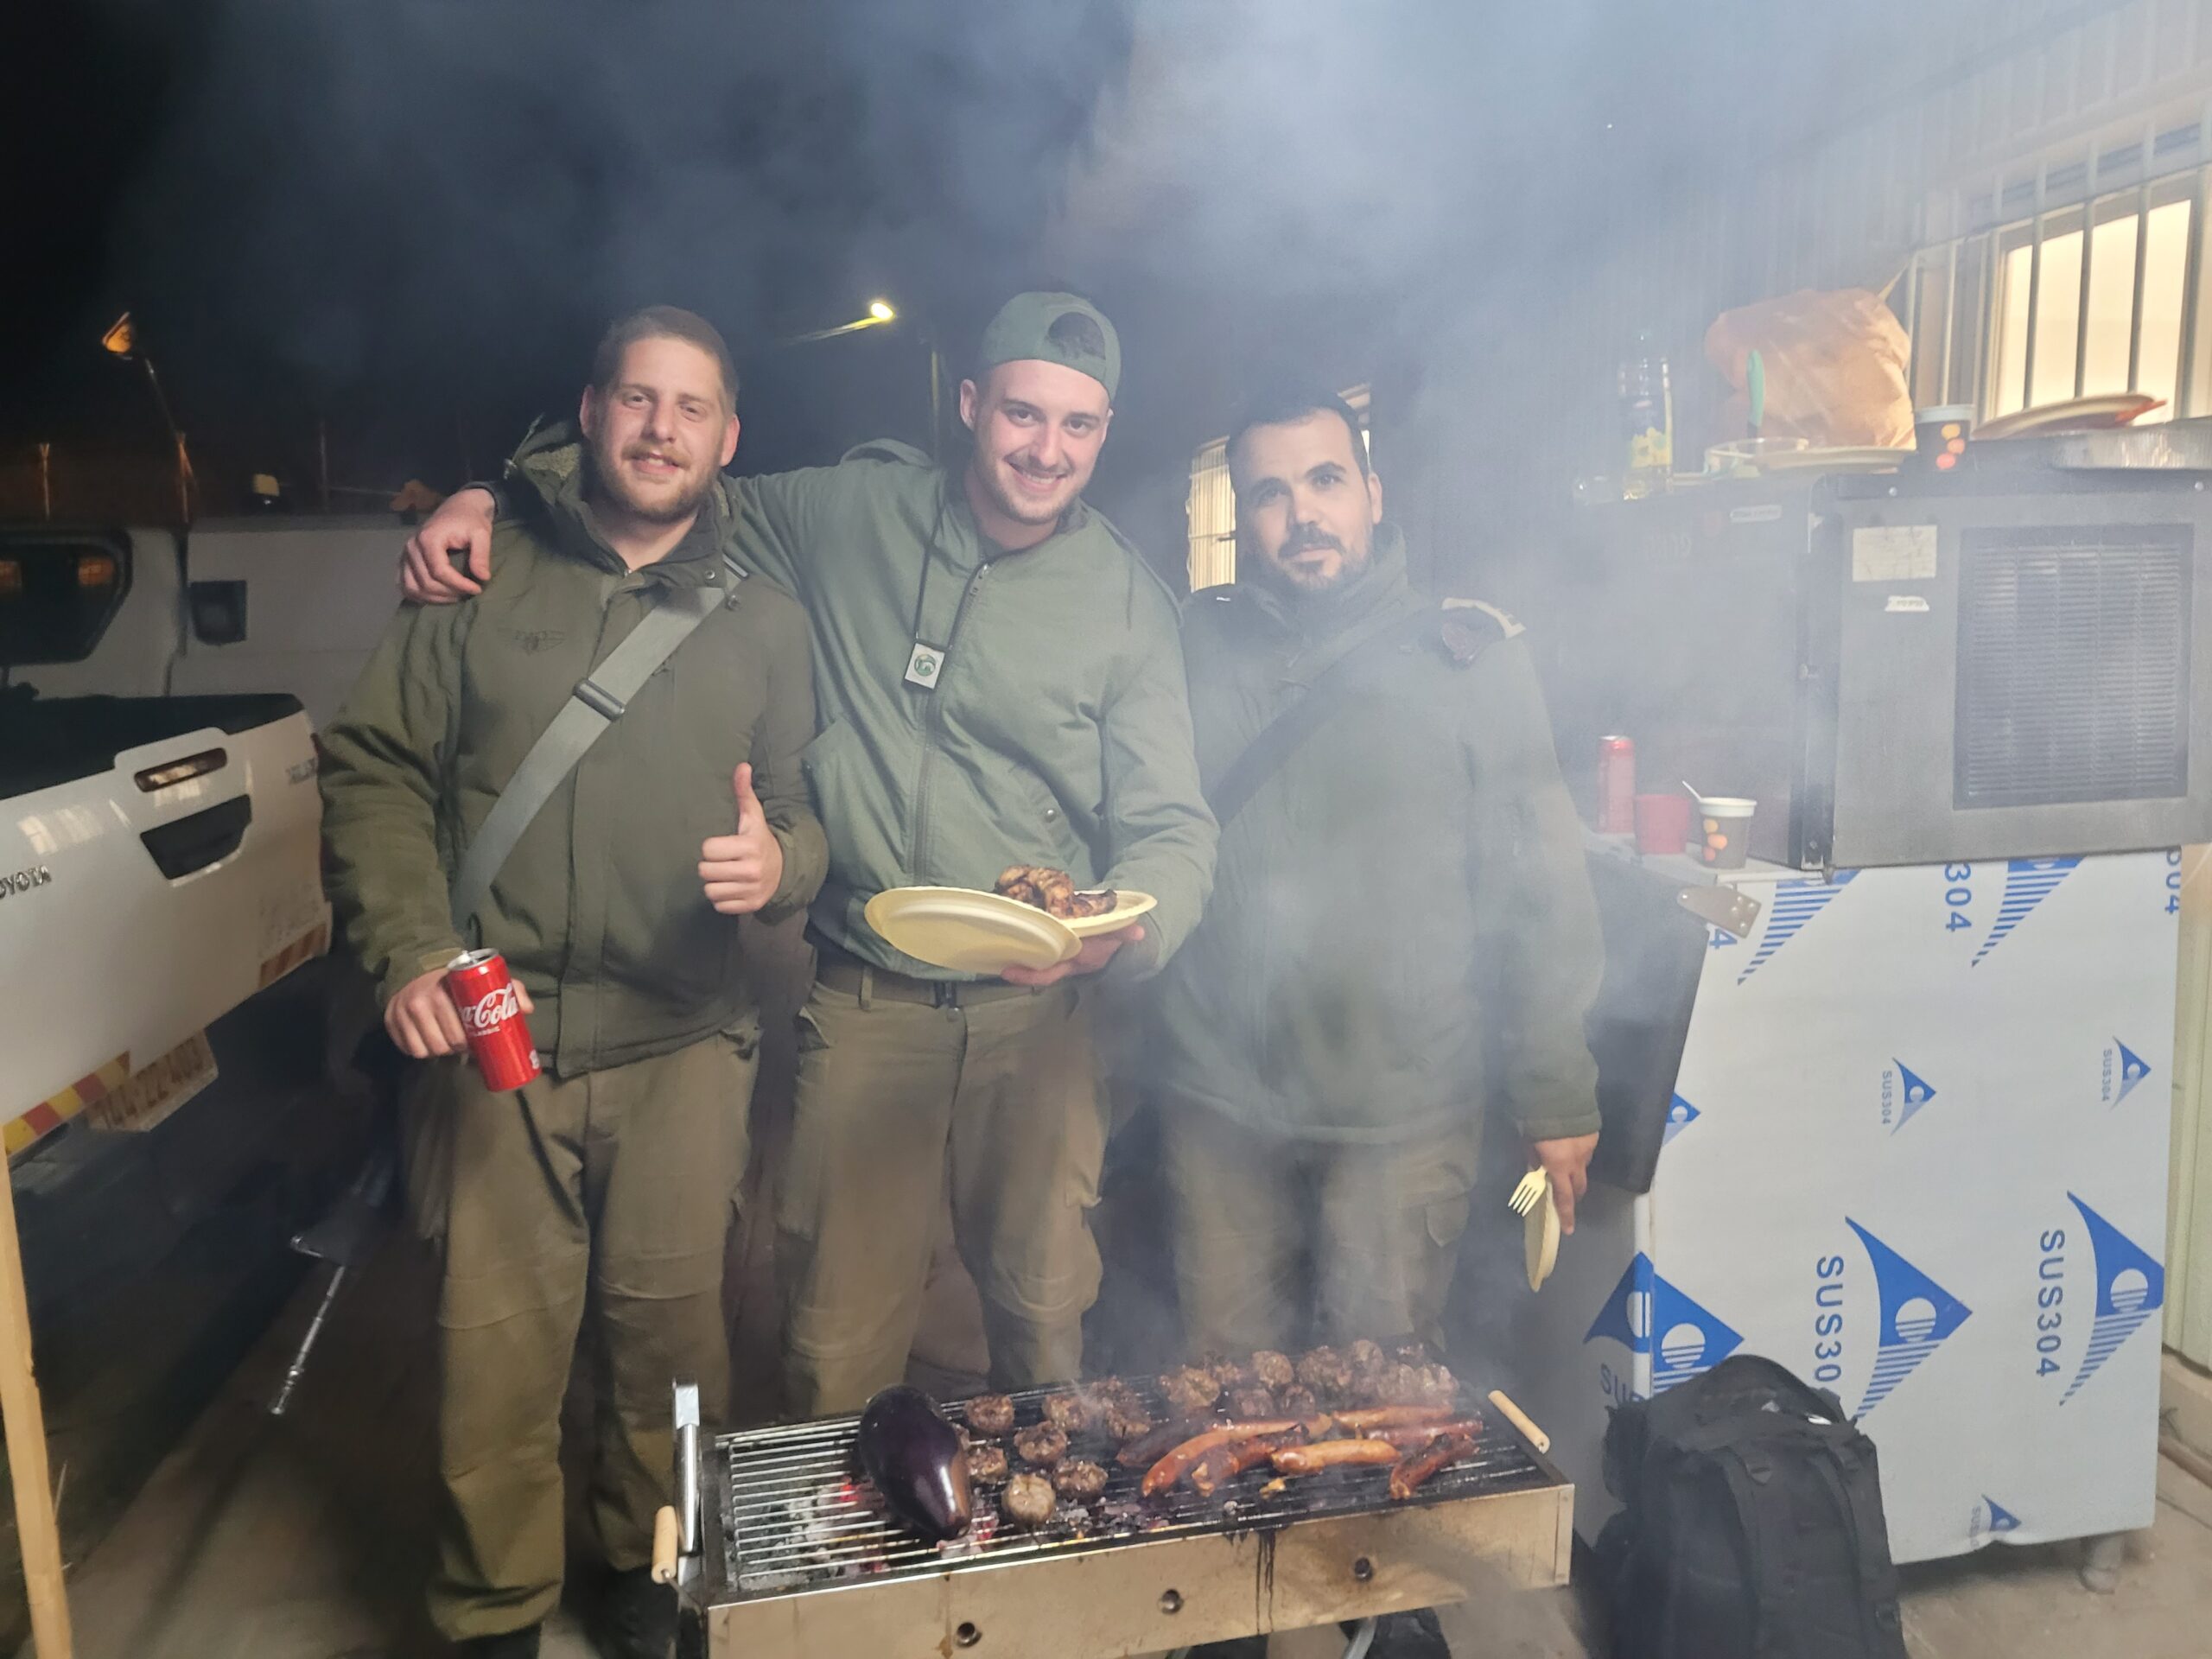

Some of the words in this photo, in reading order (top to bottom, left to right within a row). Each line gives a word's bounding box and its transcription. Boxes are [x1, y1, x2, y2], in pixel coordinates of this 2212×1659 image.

[1881, 1071, 1892, 1124] SUS304
[2101, 1049, 2113, 1102] SUS304
[1815, 1255, 1845, 1382] SUS30
[2036, 1229, 2066, 1377] SUS304
